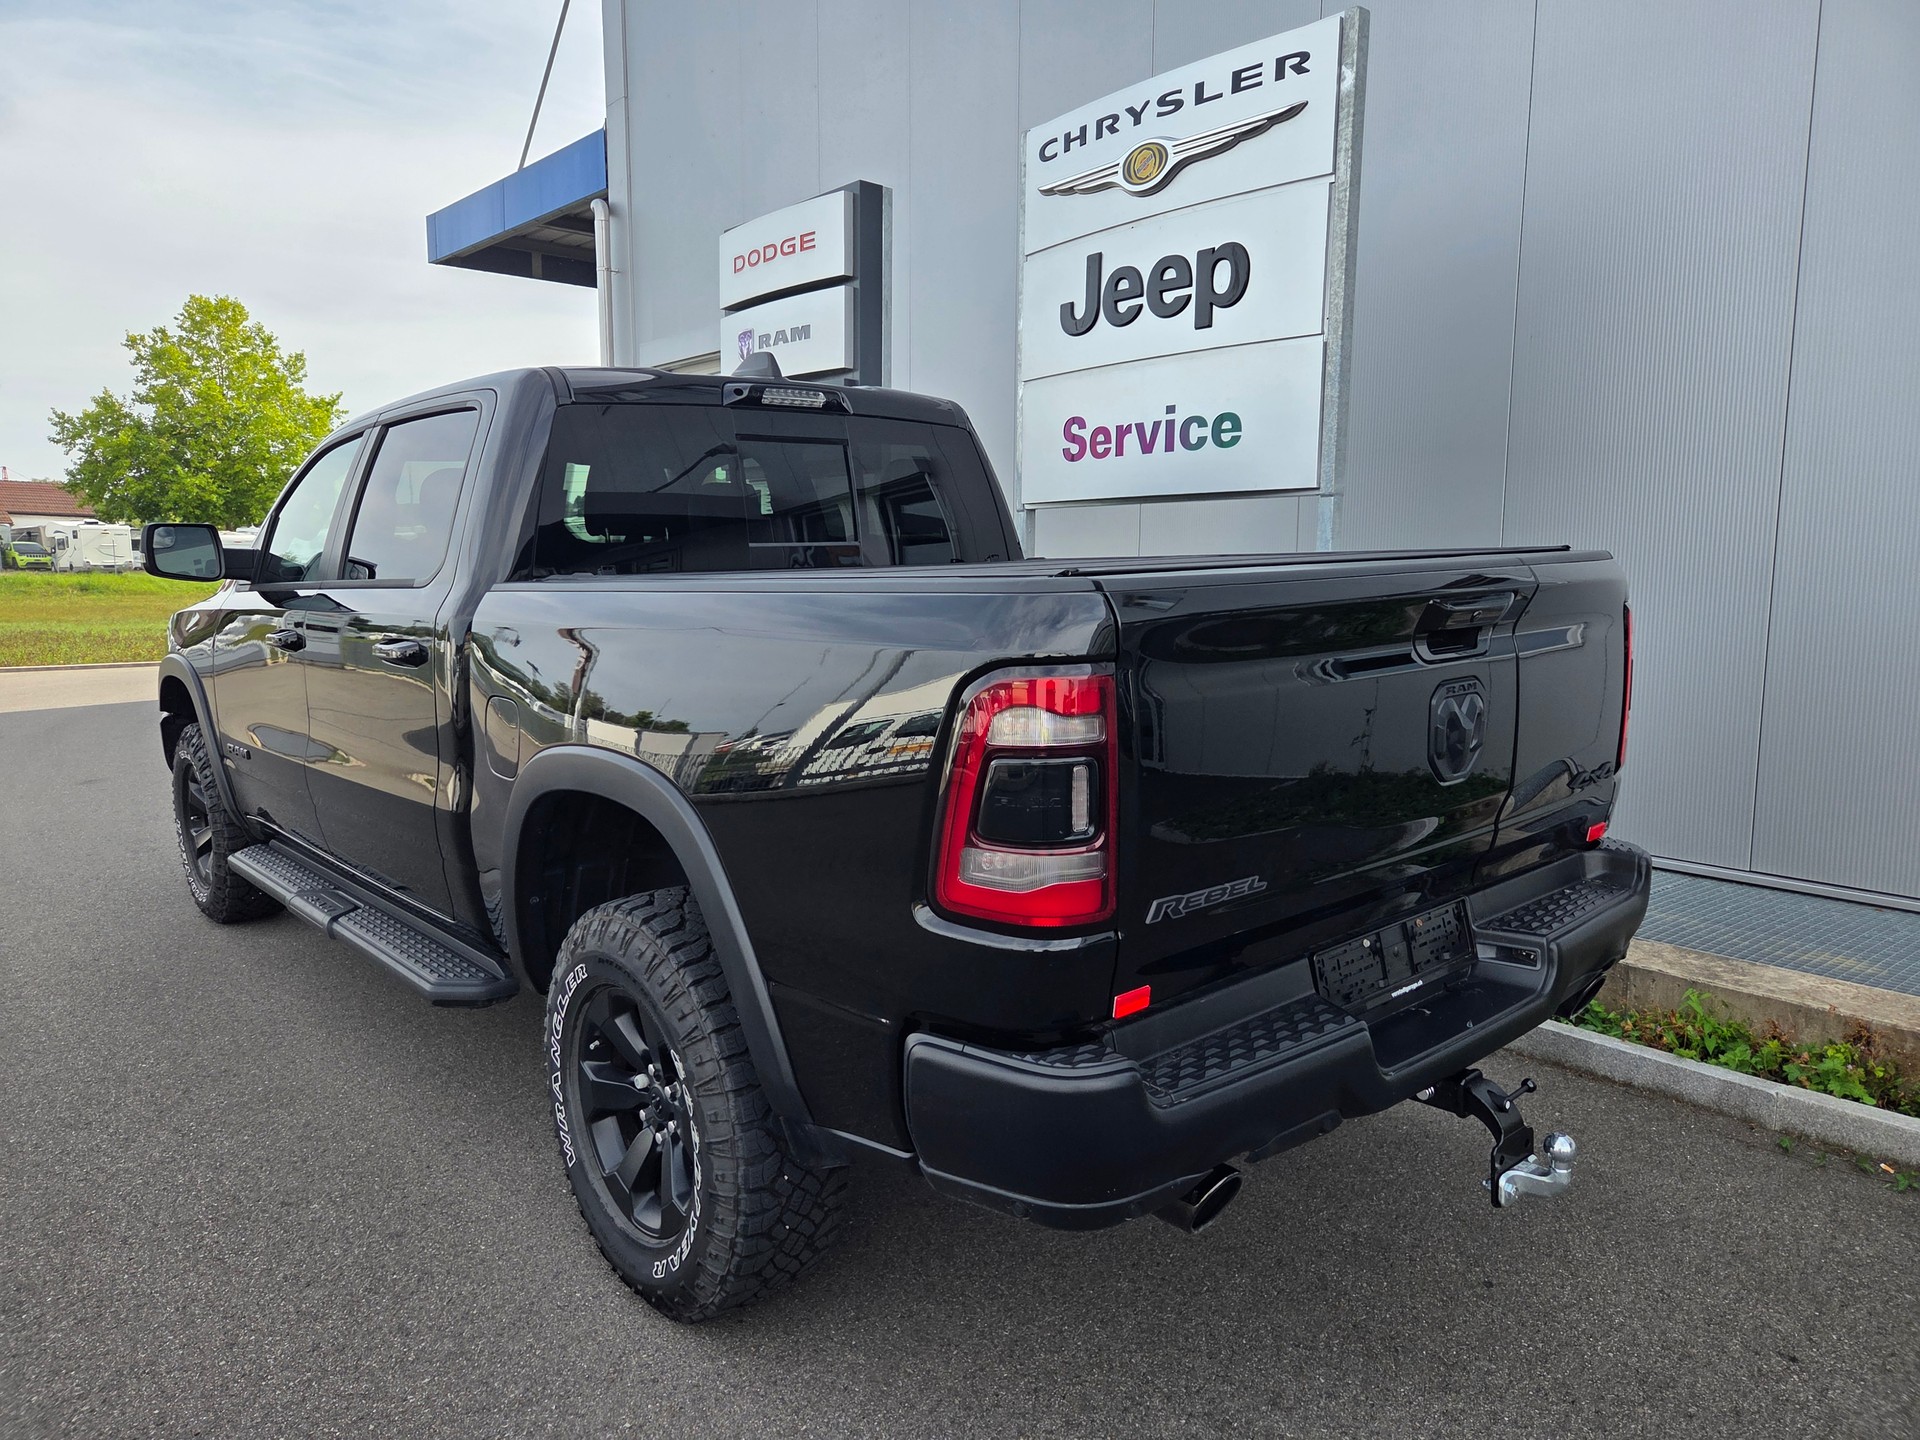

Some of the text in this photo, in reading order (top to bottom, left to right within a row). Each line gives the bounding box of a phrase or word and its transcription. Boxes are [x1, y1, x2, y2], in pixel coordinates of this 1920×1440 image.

[1039, 51, 1311, 162] CHRYSLER
[734, 231, 816, 274] DODGE
[1060, 241, 1250, 337] Jeep
[758, 324, 811, 349] RAM
[1062, 405, 1242, 462] Service
[1445, 682, 1478, 695] RAM
[1145, 876, 1268, 924] REBEL
[550, 963, 589, 1168] WRANGLER
